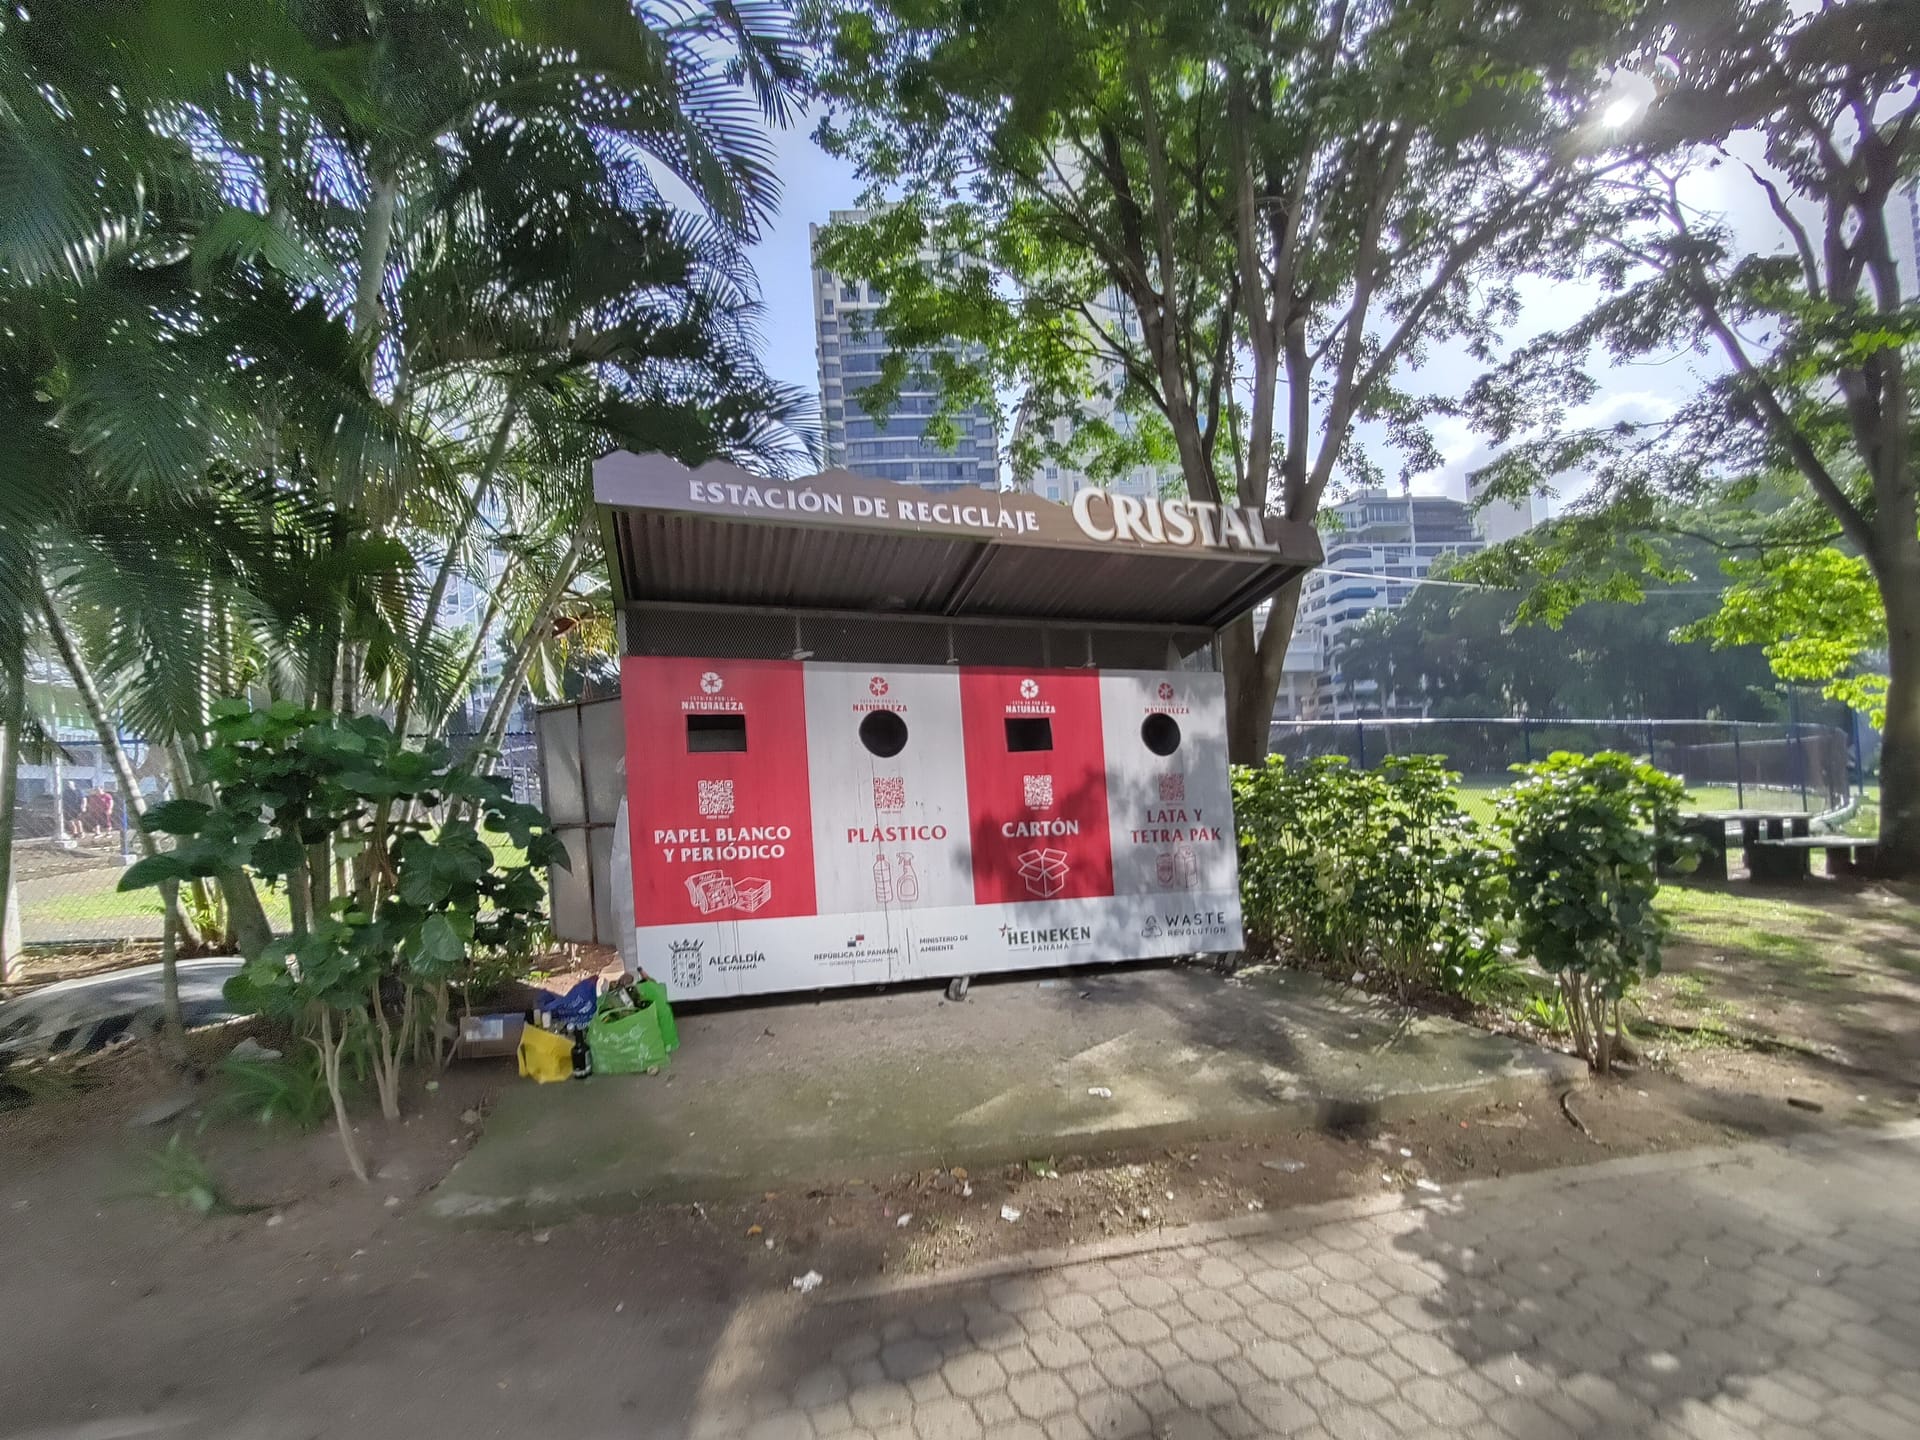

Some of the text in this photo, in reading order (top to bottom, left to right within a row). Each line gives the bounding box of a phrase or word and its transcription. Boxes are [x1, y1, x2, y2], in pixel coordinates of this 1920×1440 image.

[689, 478, 1281, 554] ESTACIÓN DE RECICLAJE CRISTAL
[681, 701, 744, 711] NATURALEZA
[1147, 808, 1202, 823] LATA Y
[654, 825, 791, 844] PAPEL BLANCO
[1002, 817, 1079, 838] CARTÓN
[1131, 827, 1221, 844] TETRA PAK
[664, 842, 785, 862] Y PERIÓDICO
[1165, 911, 1226, 927] WASTE
[919, 935, 959, 944] MINISTERIO
[1007, 926, 1091, 946] HEINEKEN
[1167, 926, 1227, 937] REVOLUTION
[856, 949, 865, 957] DE
[919, 943, 954, 953] AMBIENTE
[709, 950, 765, 966] ALCALDÍA
